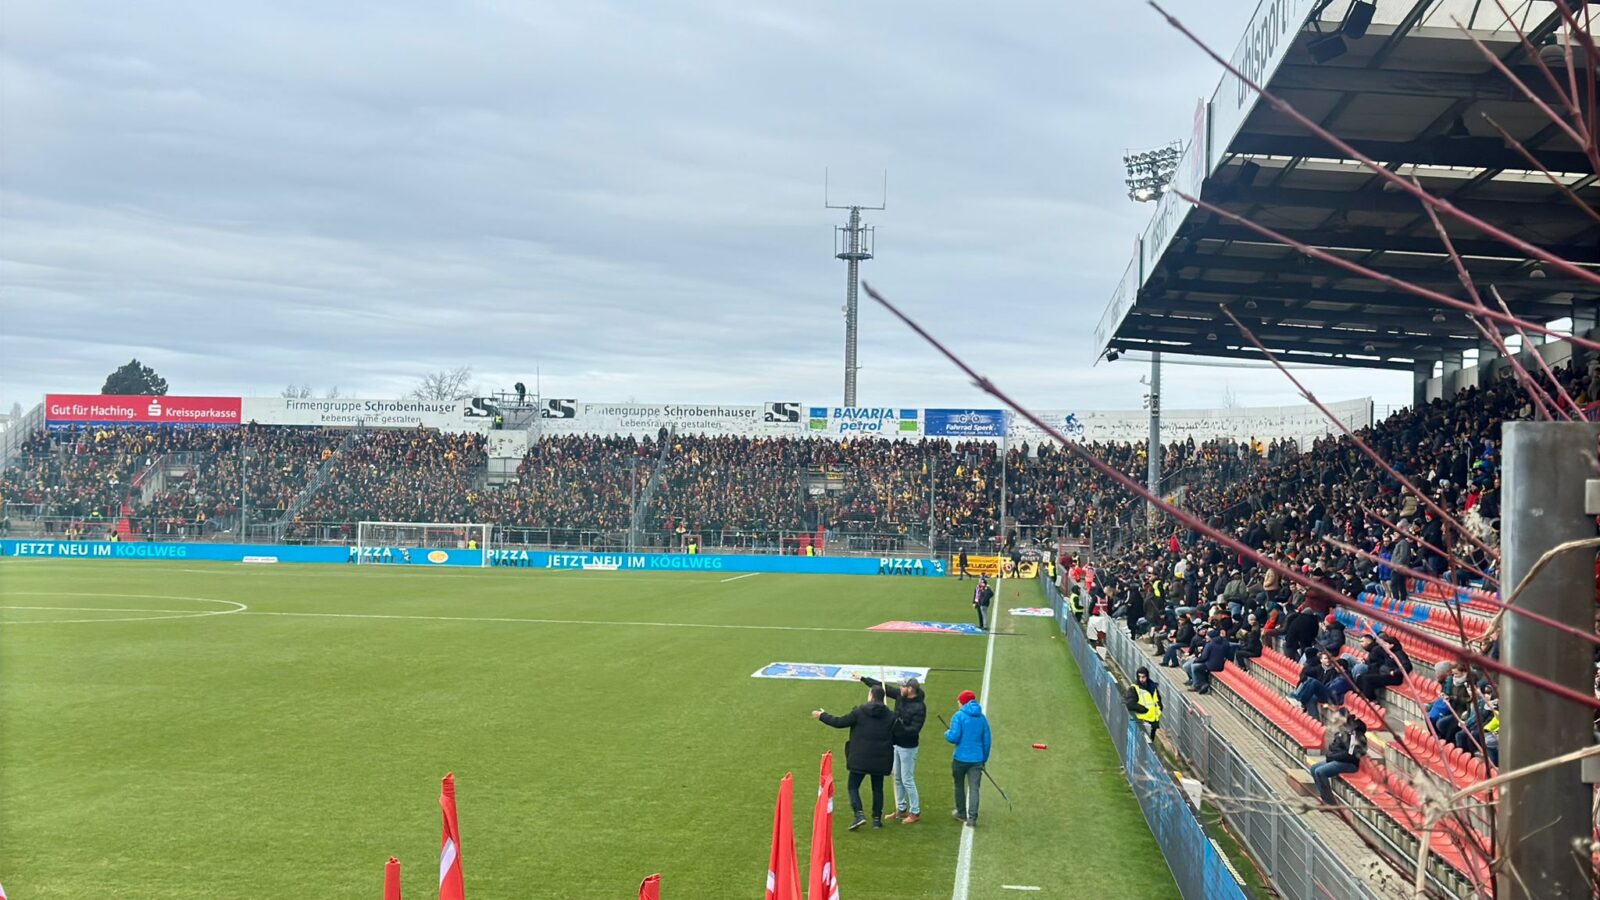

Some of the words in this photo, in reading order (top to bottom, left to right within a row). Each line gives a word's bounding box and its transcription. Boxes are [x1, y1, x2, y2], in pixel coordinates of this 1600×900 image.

[51, 404, 71, 415] Gut
[72, 404, 88, 415] für
[91, 404, 137, 418] Haching.
[166, 407, 237, 418] Kreissparkasse
[286, 400, 361, 413] Firmengruppe
[364, 401, 457, 413] Schrobenhauser
[584, 405, 660, 417] Fmengruppe
[663, 405, 756, 418] Schrobenhauser
[833, 407, 895, 419] BAVARIA
[839, 419, 883, 433] petrol
[13, 543, 54, 556] JETZT
[58, 543, 89, 555] NEU
[93, 544, 111, 556] IM
[116, 542, 187, 557] KÖGLWEG
[349, 546, 392, 556] PIZZA
[486, 549, 529, 559] PIZZA
[546, 555, 588, 568] JETZT
[592, 555, 623, 568] NEU
[627, 556, 645, 568] IM
[651, 554, 722, 569] KÖGLWEG
[880, 558, 924, 568] PIZZA
[878, 567, 926, 576] AVANTI
